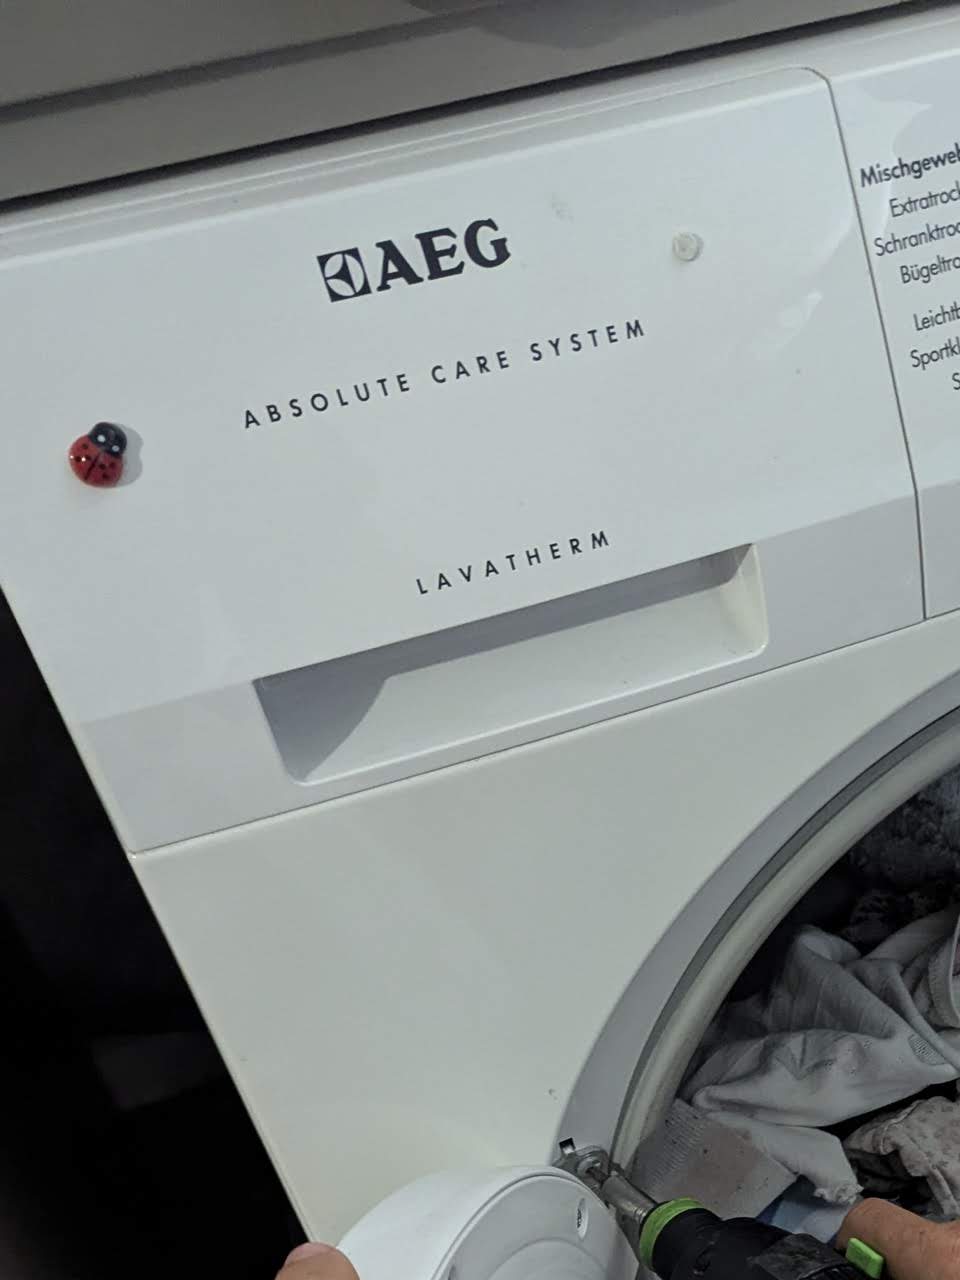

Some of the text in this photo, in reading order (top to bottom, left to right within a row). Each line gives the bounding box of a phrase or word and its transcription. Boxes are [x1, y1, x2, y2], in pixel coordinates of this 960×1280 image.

[376, 218, 511, 292] AEG
[244, 319, 645, 428] ABSOLUTE CARE SYSTEM
[416, 530, 609, 594] LAVATHERM
